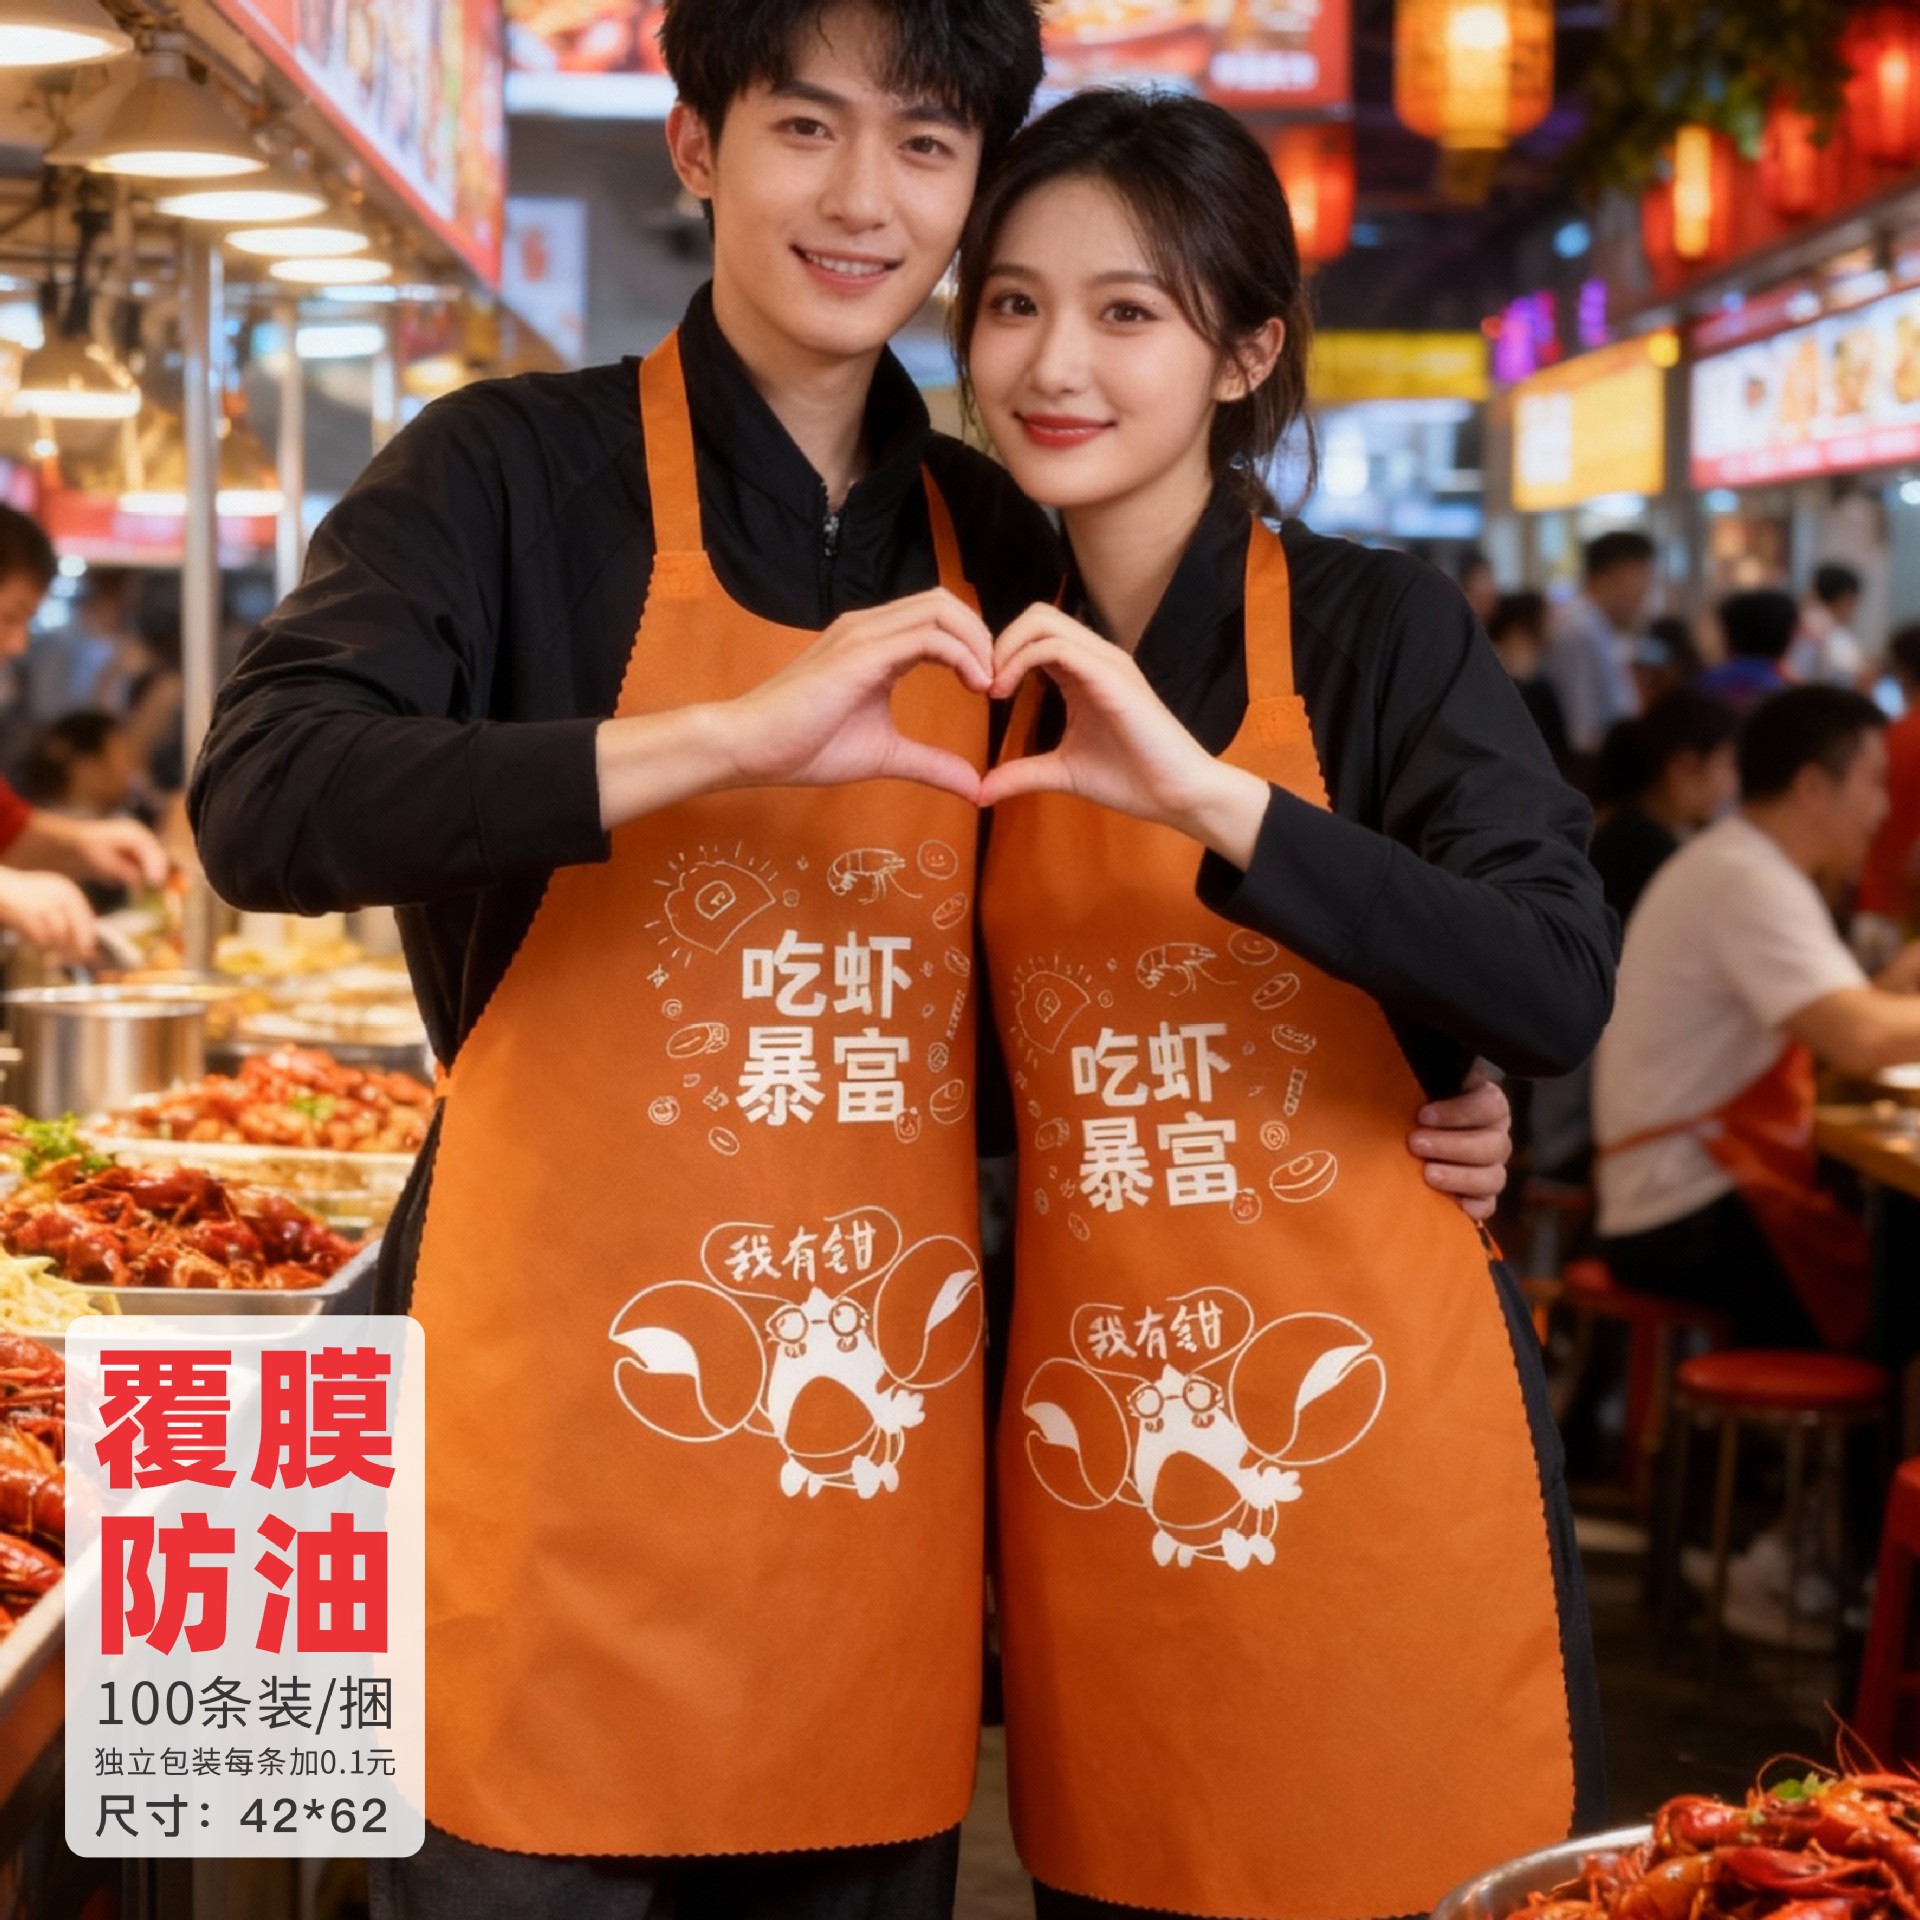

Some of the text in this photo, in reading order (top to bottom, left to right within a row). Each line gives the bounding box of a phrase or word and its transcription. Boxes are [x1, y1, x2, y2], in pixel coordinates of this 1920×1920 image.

[742, 929, 912, 1018] 吃虾
[736, 1026, 911, 1126] 暴富
[1071, 1021, 1230, 1107] 吃虾
[1079, 1111, 1237, 1213] 暴富
